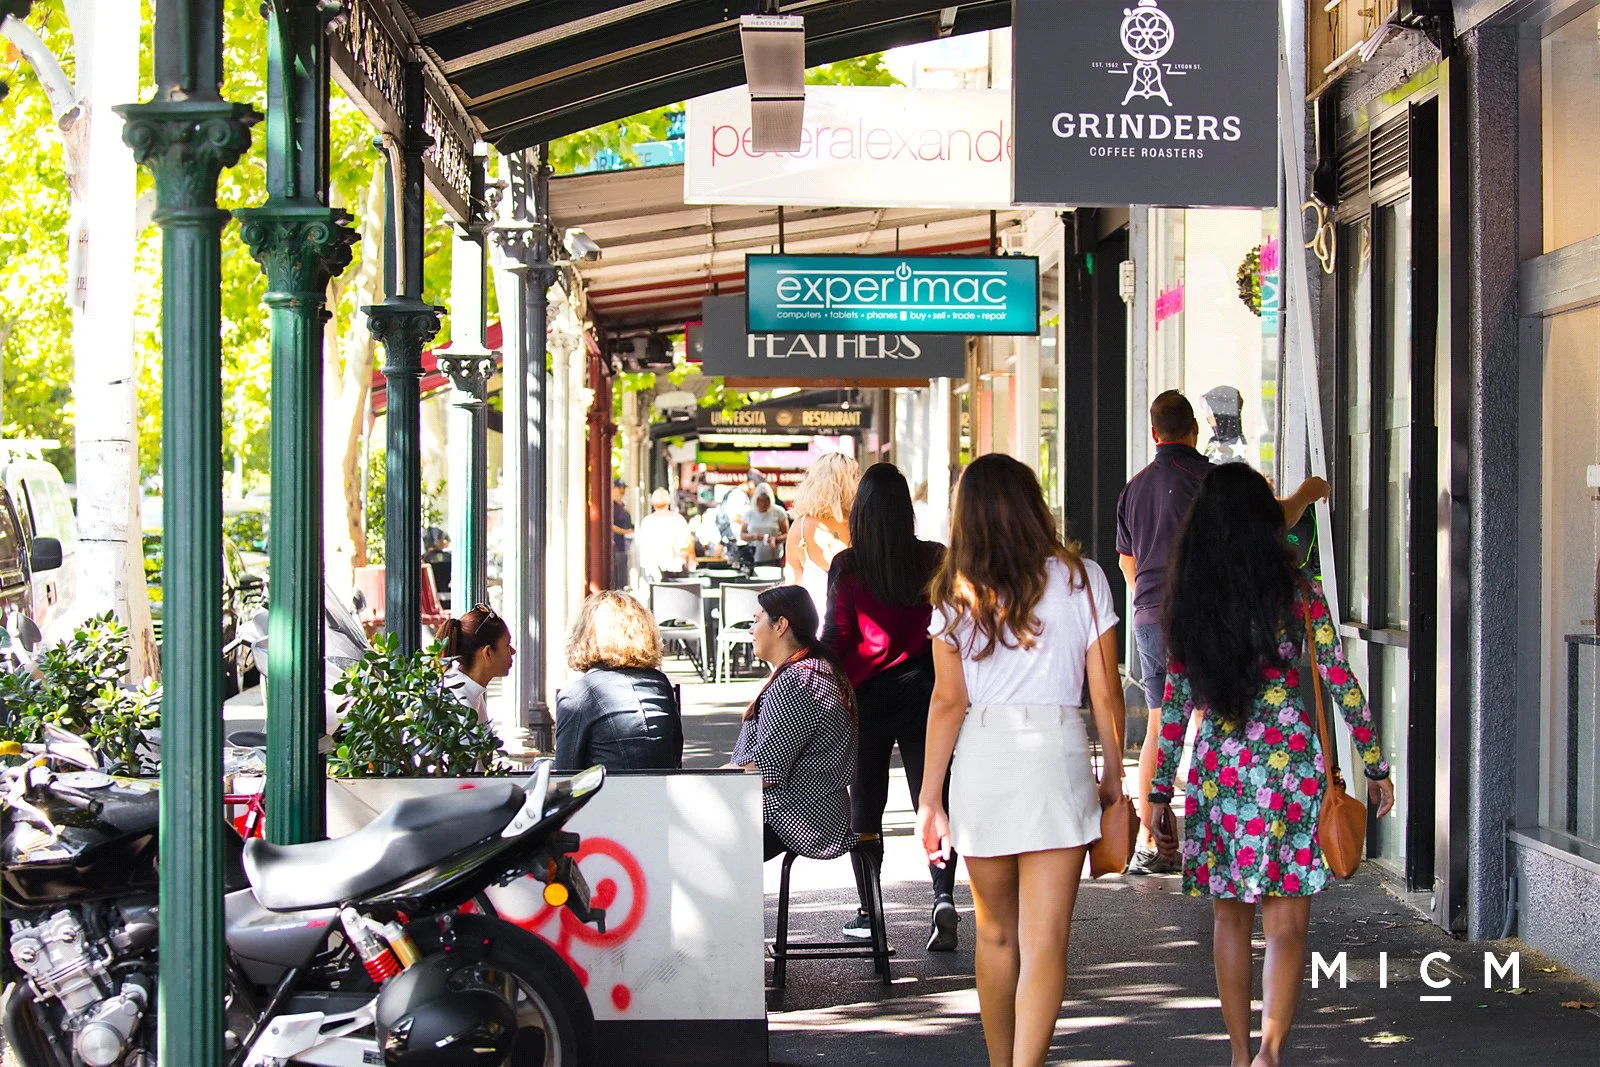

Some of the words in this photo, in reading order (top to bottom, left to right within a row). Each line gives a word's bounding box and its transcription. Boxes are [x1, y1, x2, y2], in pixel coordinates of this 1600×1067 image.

[1052, 112, 1241, 141] GRINDERS
[1089, 146, 1135, 158] COFFEE
[1141, 147, 1204, 159] ROASTERS
[776, 262, 1008, 308] experimac
[776, 311, 821, 319] computers
[830, 311, 858, 319] tablets
[866, 311, 898, 320] phones
[910, 311, 927, 321] buy
[932, 311, 946, 320] sell
[952, 311, 976, 320] trade
[981, 311, 1007, 321] repair
[802, 410, 862, 427] RESTAURANT
